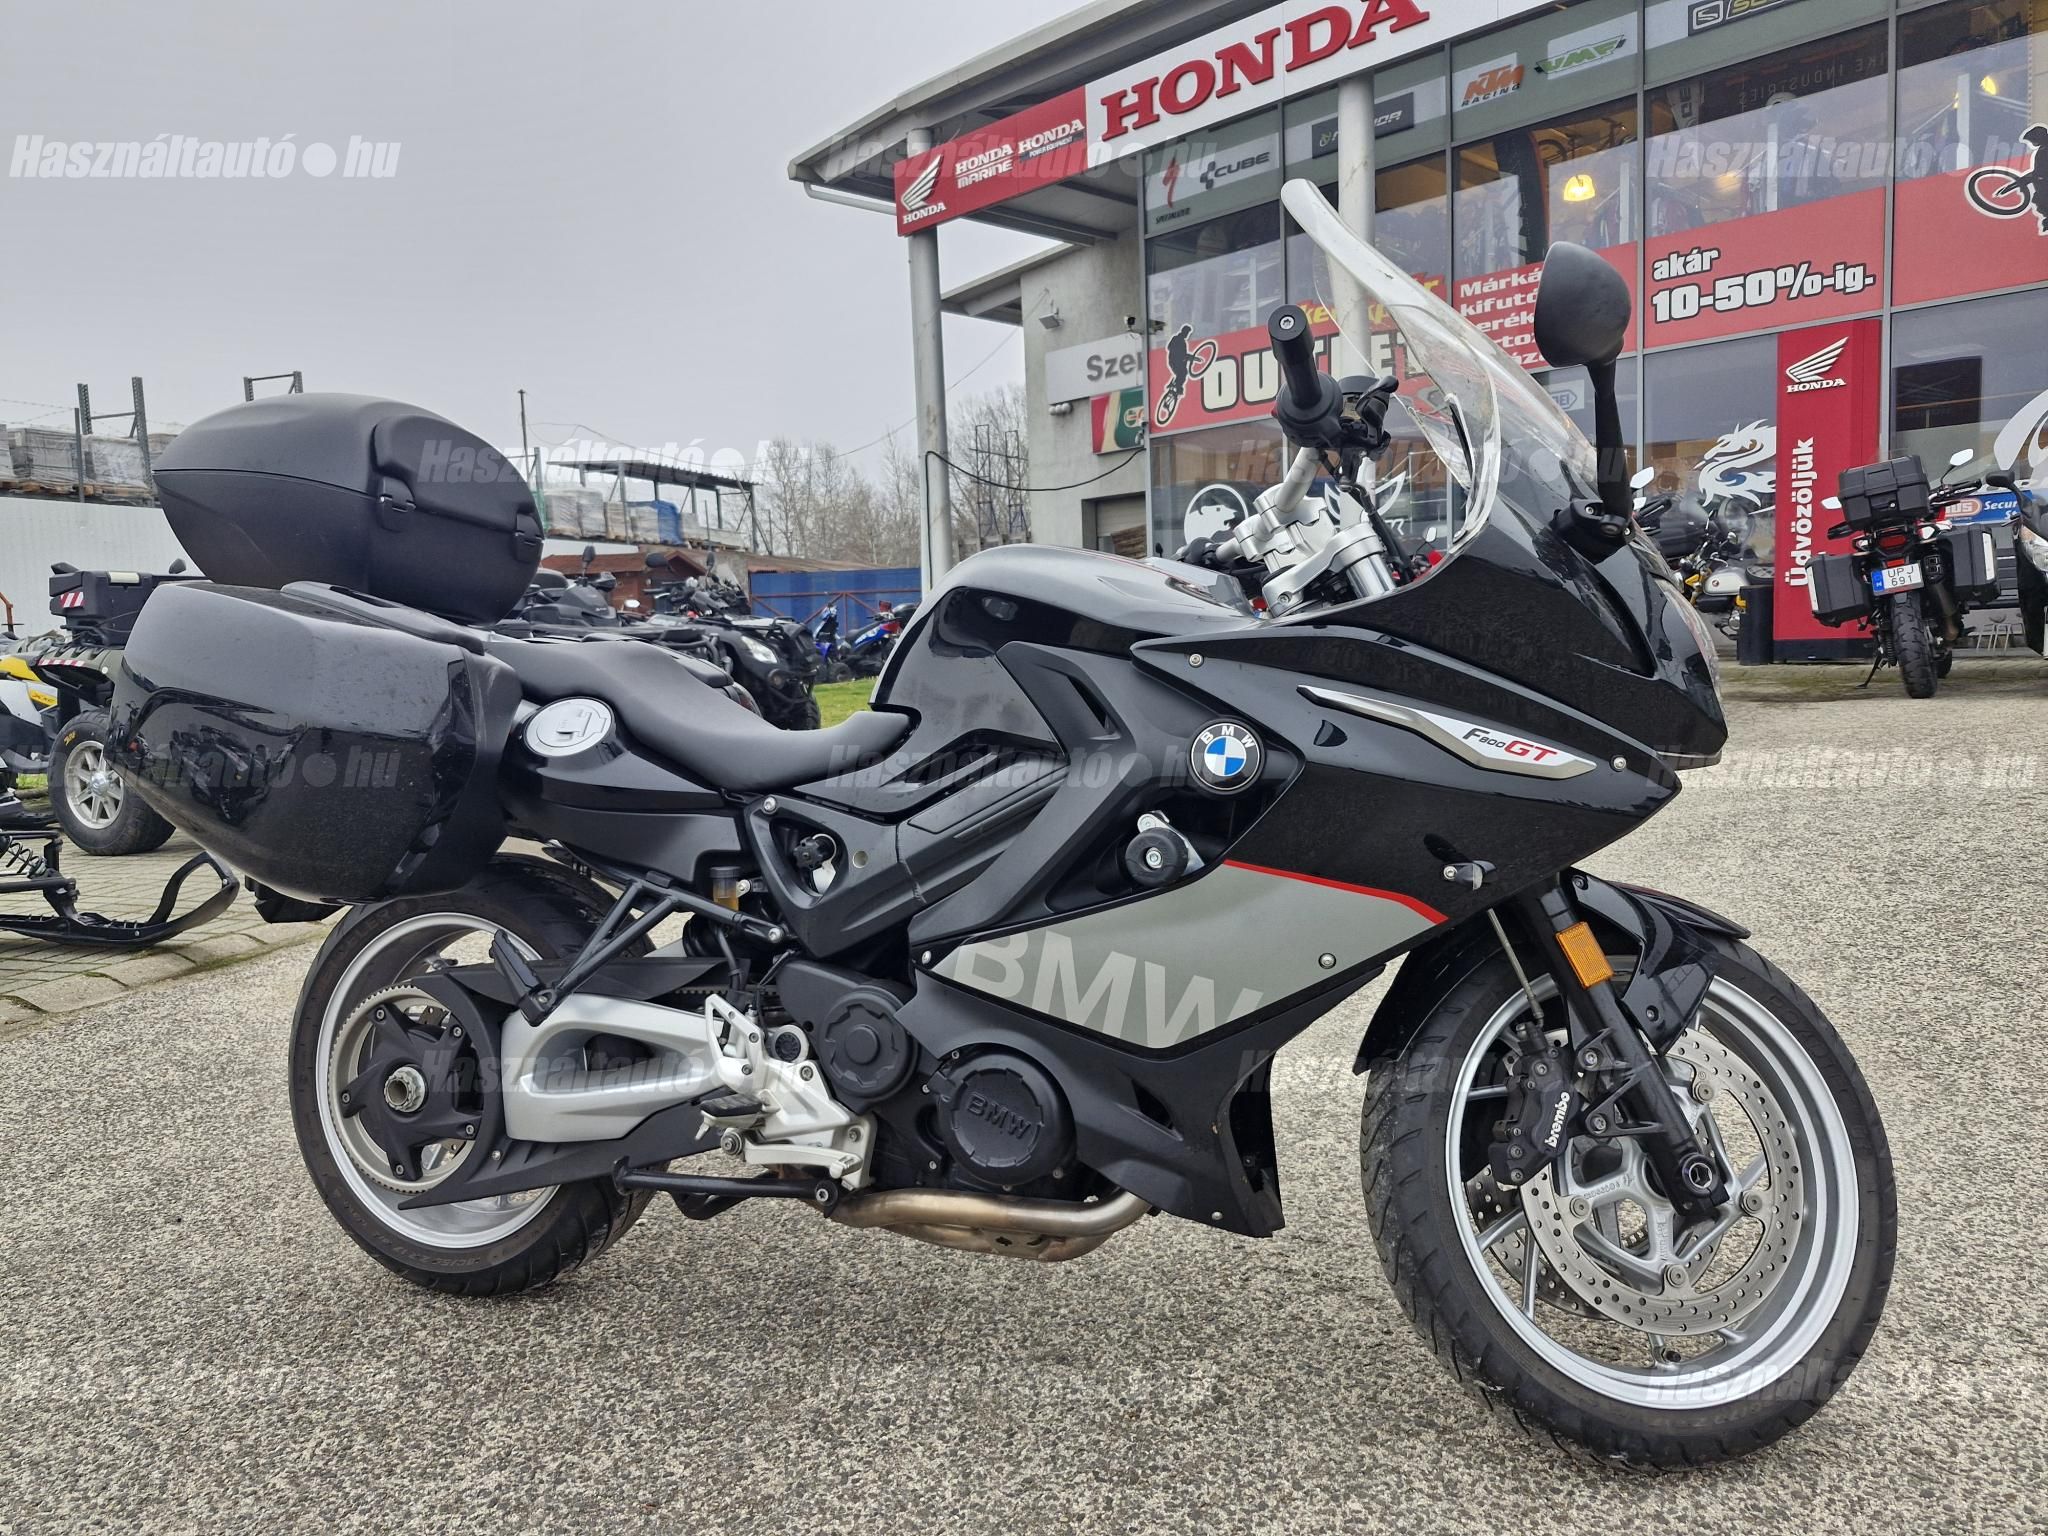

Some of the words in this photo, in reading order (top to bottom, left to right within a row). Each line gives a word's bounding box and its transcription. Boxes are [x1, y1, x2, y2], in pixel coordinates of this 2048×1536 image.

[1101, 0, 1431, 142] HONDA
[1463, 64, 1525, 100] KTM
[1461, 84, 1521, 107] RACING
[1018, 119, 1085, 154] HONDA
[955, 144, 1014, 175] HONDA
[957, 159, 1013, 190] MARINE
[1214, 151, 1270, 178] CUBE
[903, 202, 947, 225] HONDA
[1652, 246, 1721, 281] akár
[1651, 260, 1877, 324] 10-50%-ig.
[1472, 311, 1535, 334] erék
[1786, 377, 1847, 394] HONDA
[1784, 437, 1818, 587] Üdvözöljük
[1888, 566, 1914, 578] UPJ
[1891, 575, 1912, 587] 691
[1200, 725, 1256, 749] BMW
[1462, 727, 1558, 762] F800GT
[952, 929, 1264, 1049] BMW
[966, 1091, 1033, 1141] BMW
[1544, 1091, 1571, 1148] brembo
